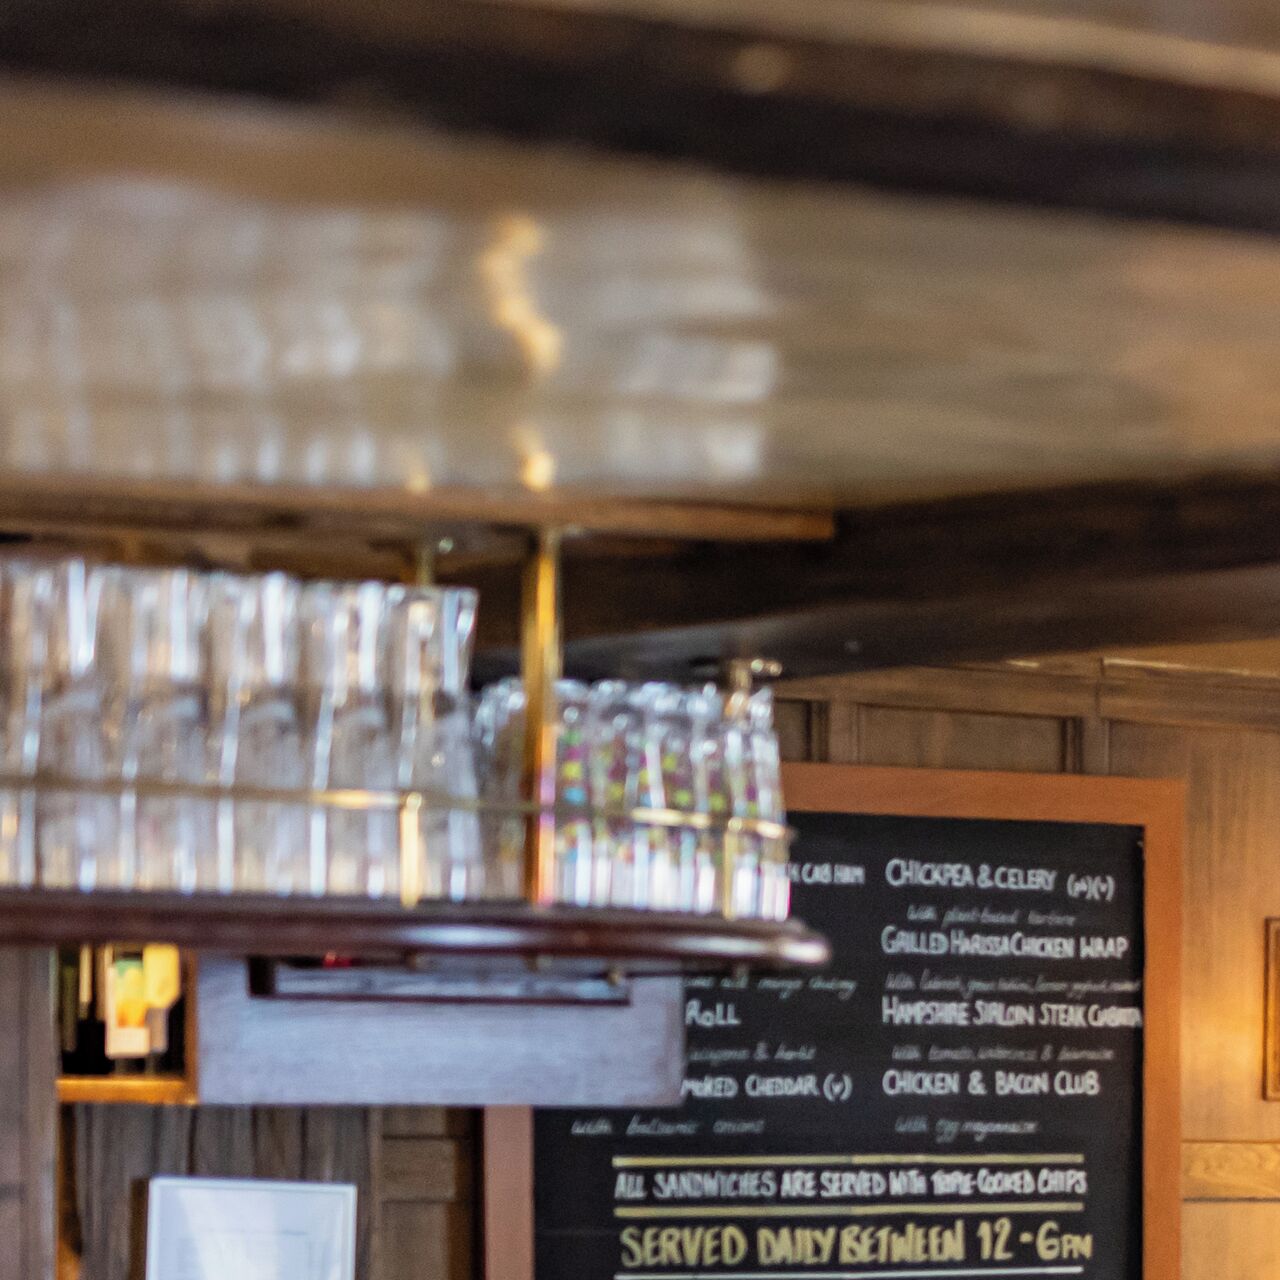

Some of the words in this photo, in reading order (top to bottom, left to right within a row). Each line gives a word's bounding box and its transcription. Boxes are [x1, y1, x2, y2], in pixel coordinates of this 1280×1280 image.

[885, 858, 974, 887] CHICKPEA
[977, 864, 993, 889] &
[994, 866, 1057, 890] CELERY
[881, 924, 949, 954] GRILLED
[1009, 931, 1075, 958] CHICKEN
[1080, 936, 1128, 959] WRAP
[882, 996, 968, 1026] HAMPSHIRE
[973, 1000, 1035, 1026] SIRLOIN
[1039, 1003, 1087, 1027] STEAK
[680, 1075, 739, 1098] MOKED
[745, 1073, 820, 1097] CHEDDAR
[882, 1069, 960, 1096] CHICKEN
[967, 1070, 988, 1095] &
[995, 1070, 1050, 1096] BACON
[1053, 1069, 1100, 1096] CLUB
[614, 1171, 647, 1199] ALL
[653, 1170, 777, 1199] SANDWICHES
[781, 1170, 816, 1198] ARE
[820, 1170, 886, 1197] SERVED
[1037, 1168, 1087, 1195] CHIPS
[620, 1225, 748, 1268] SERVED
[757, 1225, 837, 1265] DAILY
[839, 1219, 965, 1265] BETWEEN
